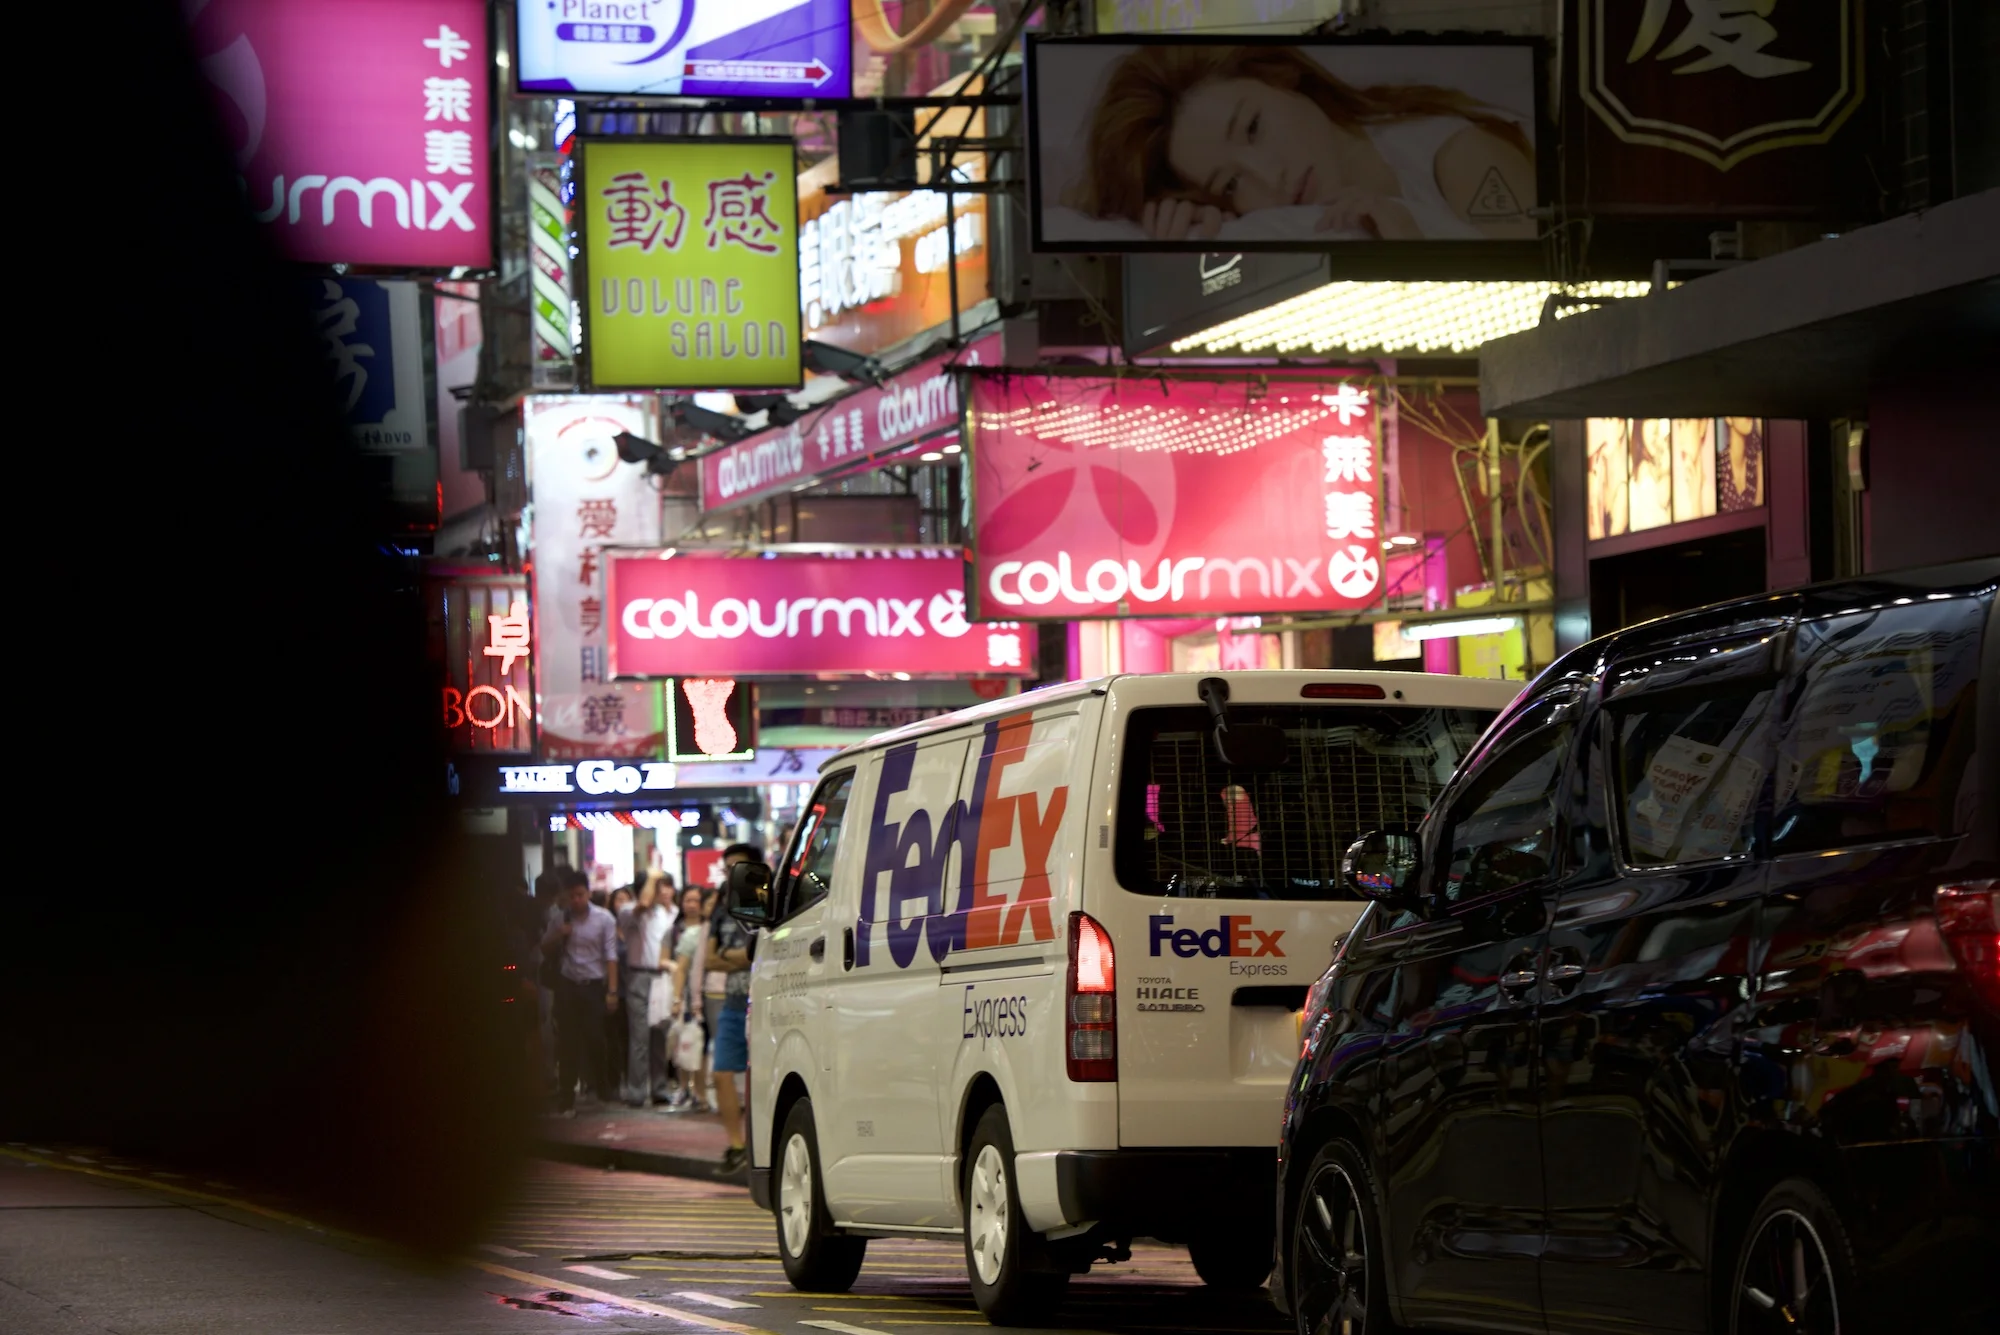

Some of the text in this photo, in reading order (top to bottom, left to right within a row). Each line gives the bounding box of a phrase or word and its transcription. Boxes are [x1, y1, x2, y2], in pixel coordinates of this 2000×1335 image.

[422, 24, 474, 175] 卡萊美
[601, 171, 783, 254] 動感
[669, 320, 788, 359] SALON
[990, 551, 1322, 606] colourmix
[621, 590, 925, 640] colourmix
[854, 710, 1069, 968] FedEx
[1149, 915, 1287, 959] FedEx
[1137, 987, 1199, 1000] HIACE
[1138, 977, 1172, 986] TOYOTA
[1229, 961, 1287, 978] Express
[962, 985, 1027, 1052] Express
